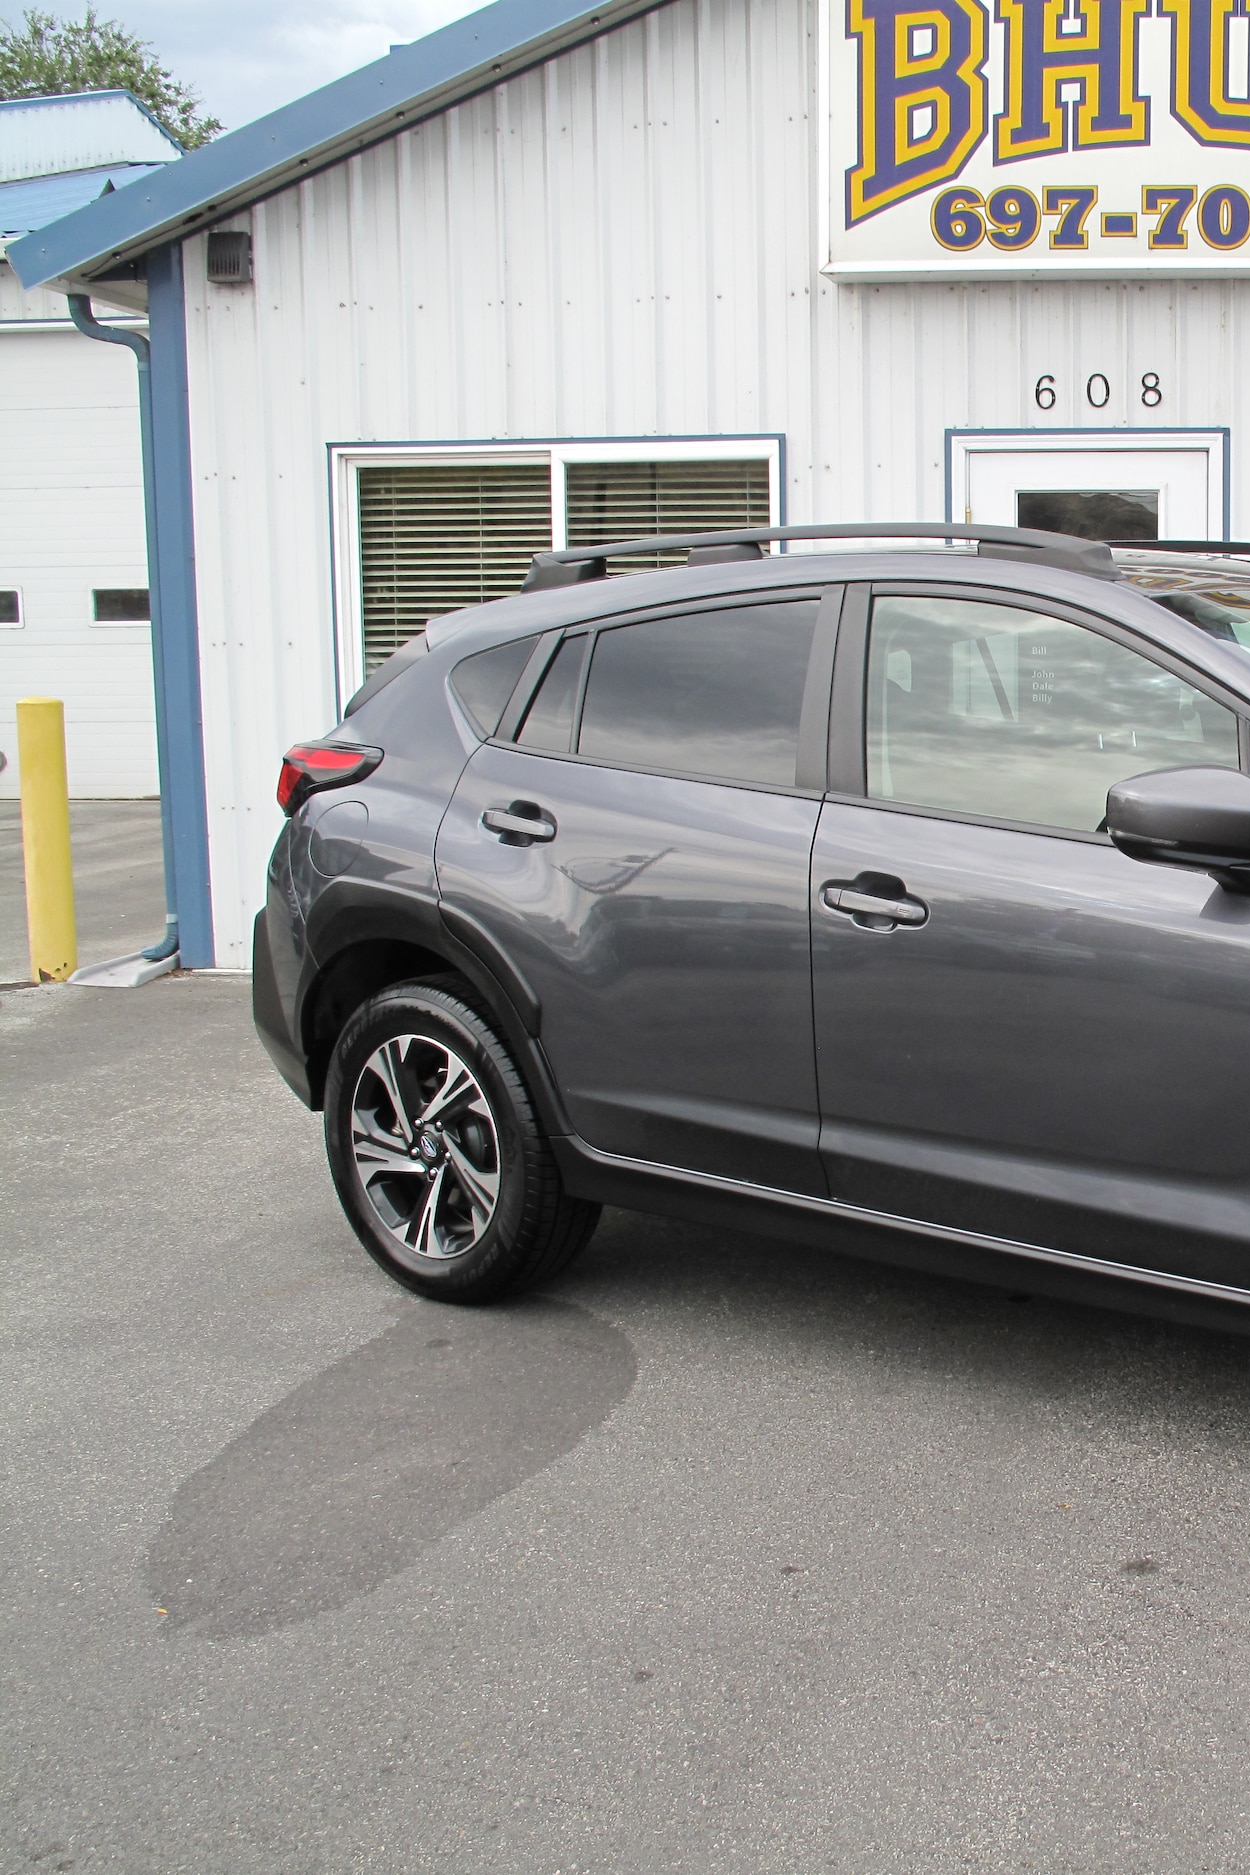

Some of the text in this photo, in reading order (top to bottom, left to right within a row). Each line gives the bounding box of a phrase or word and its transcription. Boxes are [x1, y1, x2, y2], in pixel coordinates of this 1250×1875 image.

[1035, 372, 1163, 409] 608
[1031, 646, 1047, 655] Bill
[1031, 670, 1055, 679] John
[1032, 682, 1054, 691] Dale
[1032, 694, 1053, 704] Billy
